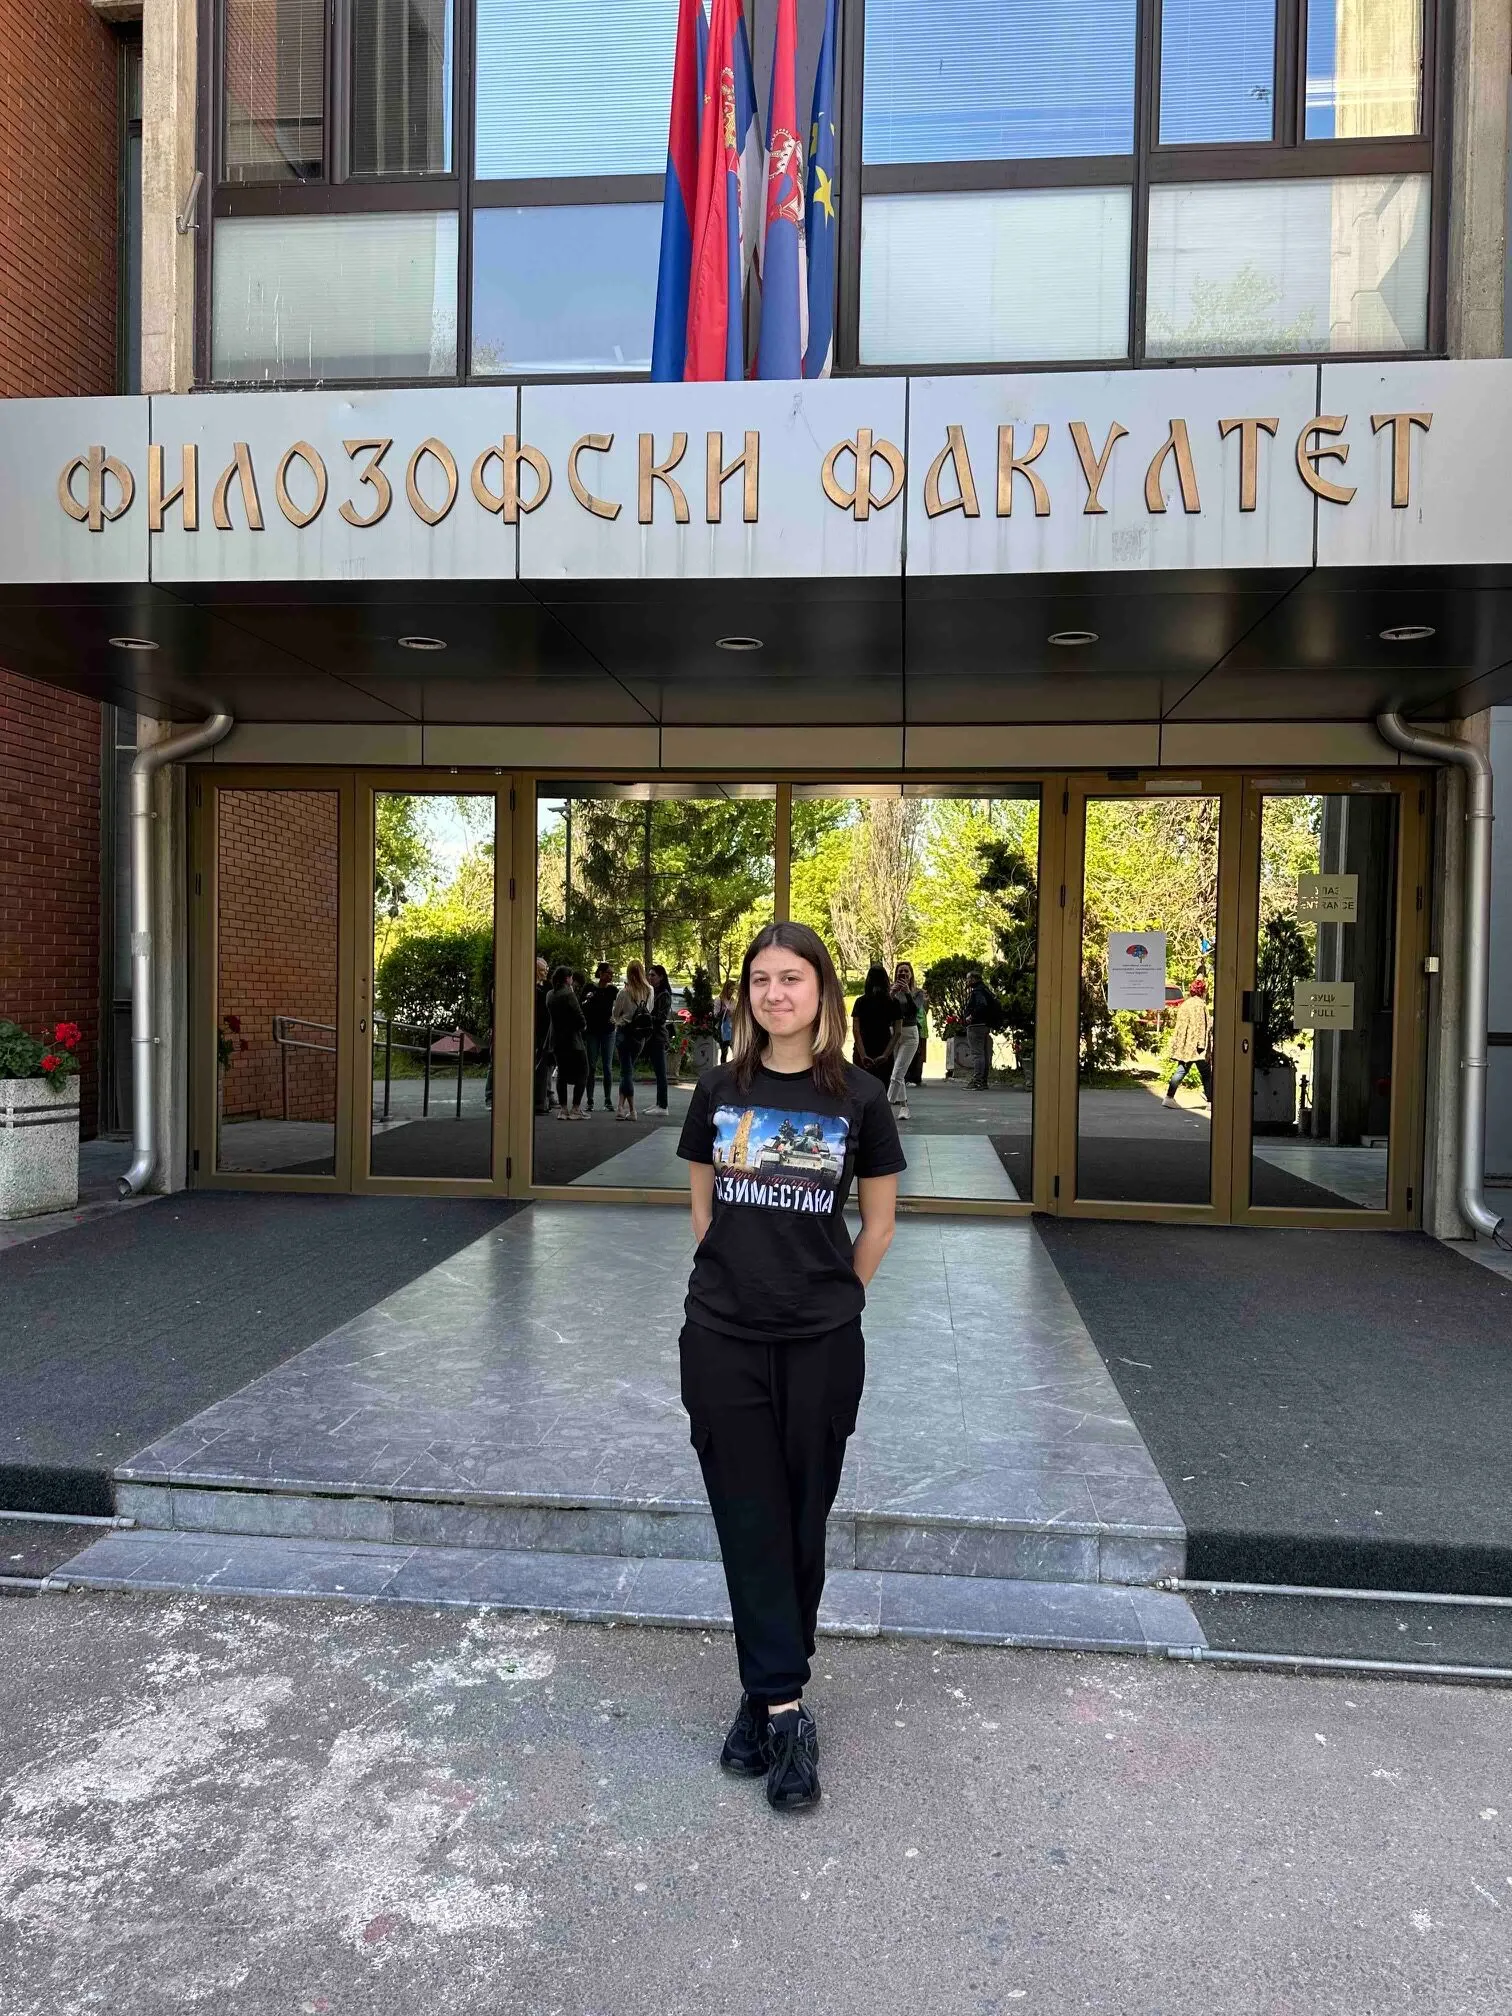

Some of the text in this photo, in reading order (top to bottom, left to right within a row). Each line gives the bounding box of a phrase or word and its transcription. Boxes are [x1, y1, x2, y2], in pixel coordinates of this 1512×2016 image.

[57, 412, 1433, 532] ФИЛОЗОФСКИ ФАКУЛТЕТ
[1310, 1009, 1336, 1017] PULL
[715, 1176, 834, 1213] АЗИМЕСТАНА
